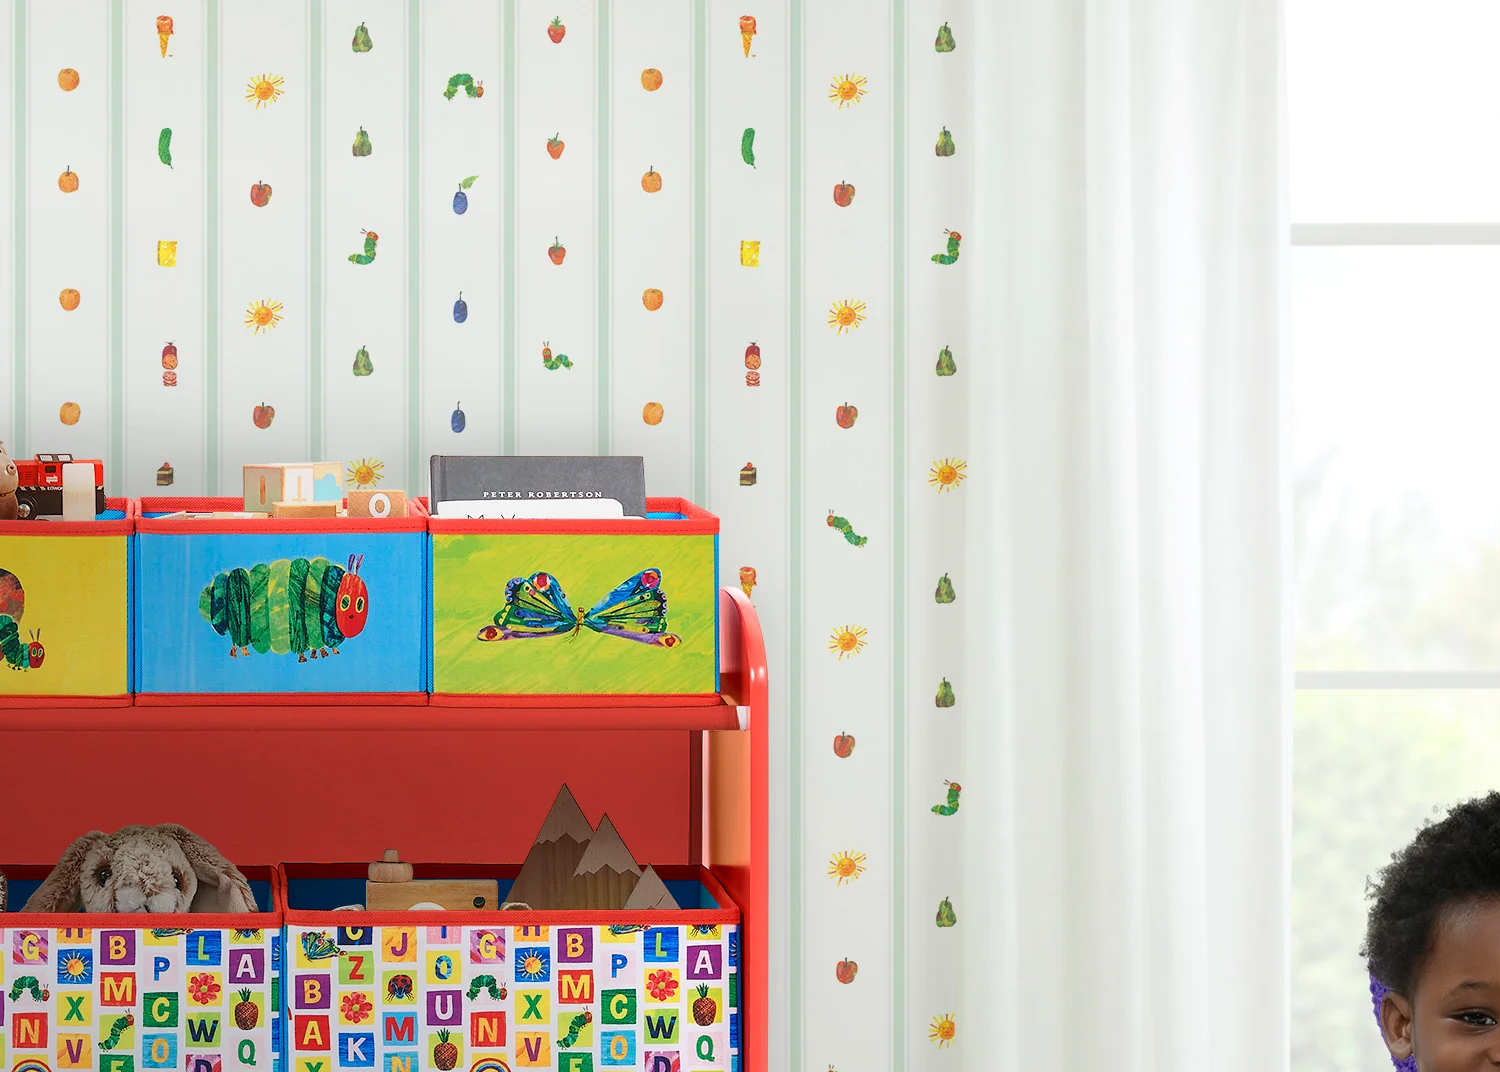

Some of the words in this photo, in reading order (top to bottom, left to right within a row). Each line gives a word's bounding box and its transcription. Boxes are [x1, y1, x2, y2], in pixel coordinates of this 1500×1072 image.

[22, 934, 39, 960] G
[109, 936, 126, 959] B
[198, 936, 209, 960] L
[391, 933, 407, 956] J
[479, 933, 496, 959] G
[567, 933, 584, 958] B
[655, 933, 667, 957] L
[154, 957, 170, 981] P
[236, 954, 256, 978] A
[349, 956, 364, 980] Z
[435, 955, 452, 980] O
[612, 954, 627, 978] P
[694, 950, 713, 975] A
[104, 977, 132, 1001] M
[304, 980, 322, 1004] B
[562, 974, 590, 999] M
[64, 997, 84, 1021] X
[152, 997, 169, 1022] C
[435, 995, 453, 1020] U
[523, 995, 542, 1019] X
[610, 994, 628, 1019] C
[20, 1019, 39, 1043] N
[188, 1019, 218, 1042] W
[303, 1021, 322, 1045] A
[385, 1017, 414, 1041] M
[479, 1018, 498, 1042] N
[646, 1016, 676, 1039] W
[66, 1039, 83, 1063] V
[152, 1038, 168, 1062] O
[238, 1039, 256, 1066] Q
[348, 1037, 366, 1061] K
[524, 1037, 541, 1061] V
[610, 1036, 628, 1060] O
[696, 1035, 715, 1062] Q
